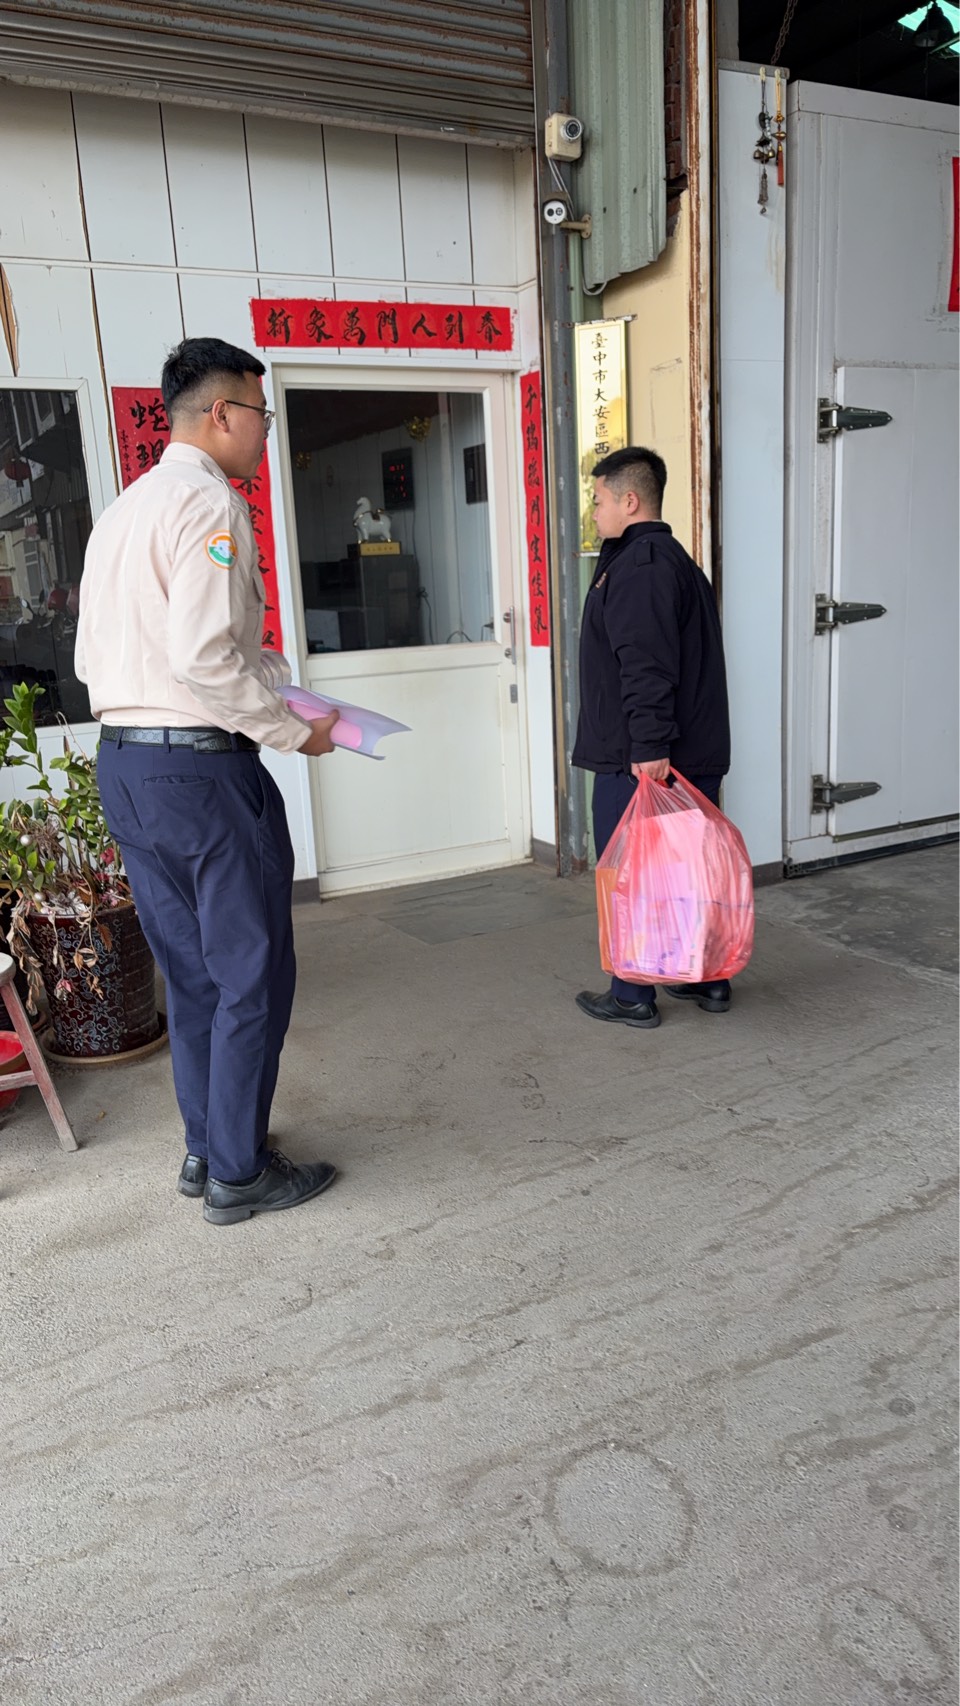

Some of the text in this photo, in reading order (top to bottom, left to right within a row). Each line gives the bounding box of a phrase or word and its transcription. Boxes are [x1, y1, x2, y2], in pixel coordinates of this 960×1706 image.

[591, 332, 611, 462] 臺中市大安區西
